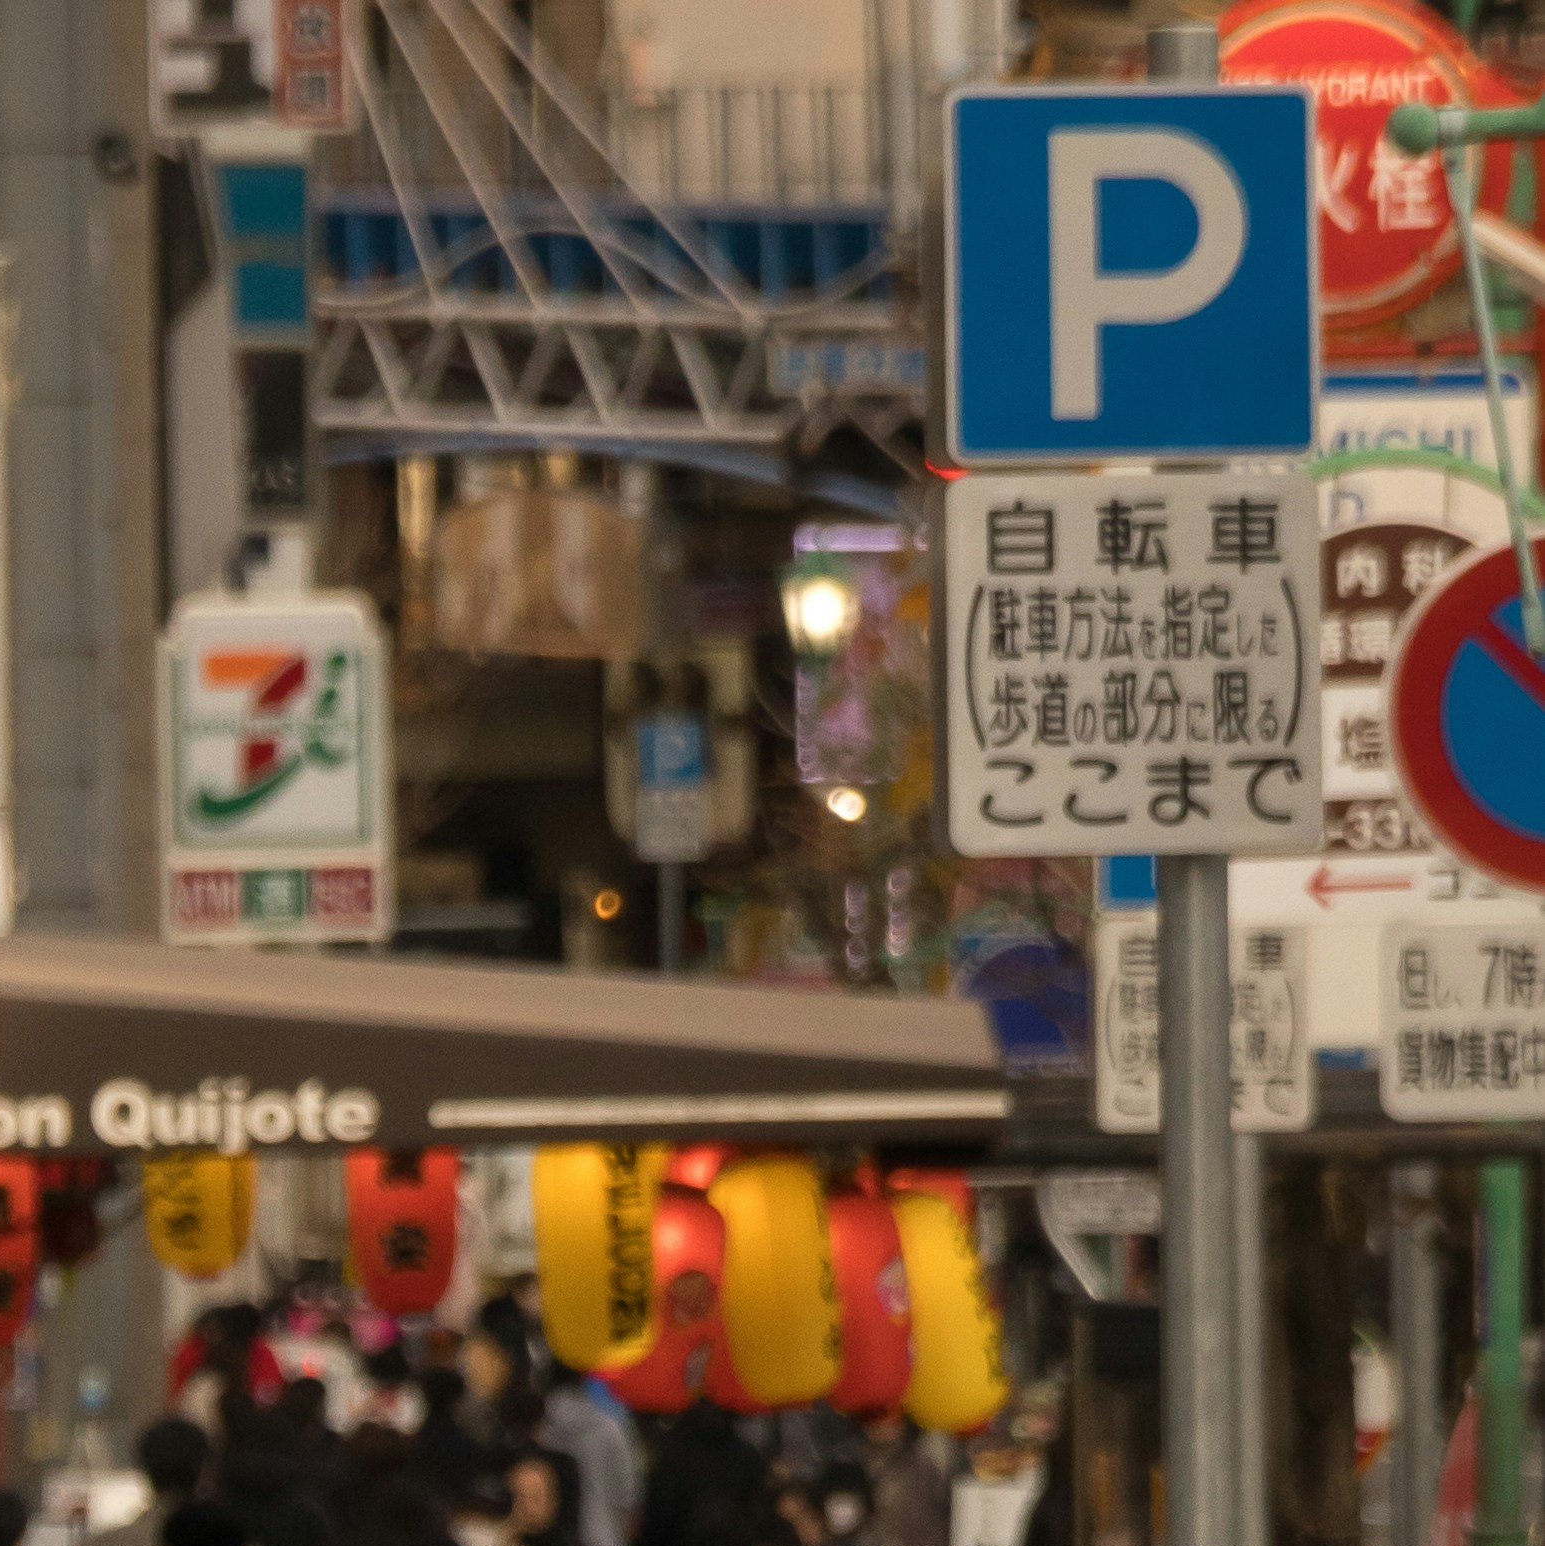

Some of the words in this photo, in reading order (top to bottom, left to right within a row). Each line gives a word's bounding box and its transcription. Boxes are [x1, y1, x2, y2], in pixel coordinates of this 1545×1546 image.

[1048, 125, 1250, 421] P
[986, 497, 1280, 575] 自転車
[987, 584, 1279, 661] 駐車方法を指定した
[988, 671, 1280, 748] 歩道の部分に限る
[979, 756, 1303, 826] ここまで
[89, 1076, 380, 1157] Quijote
